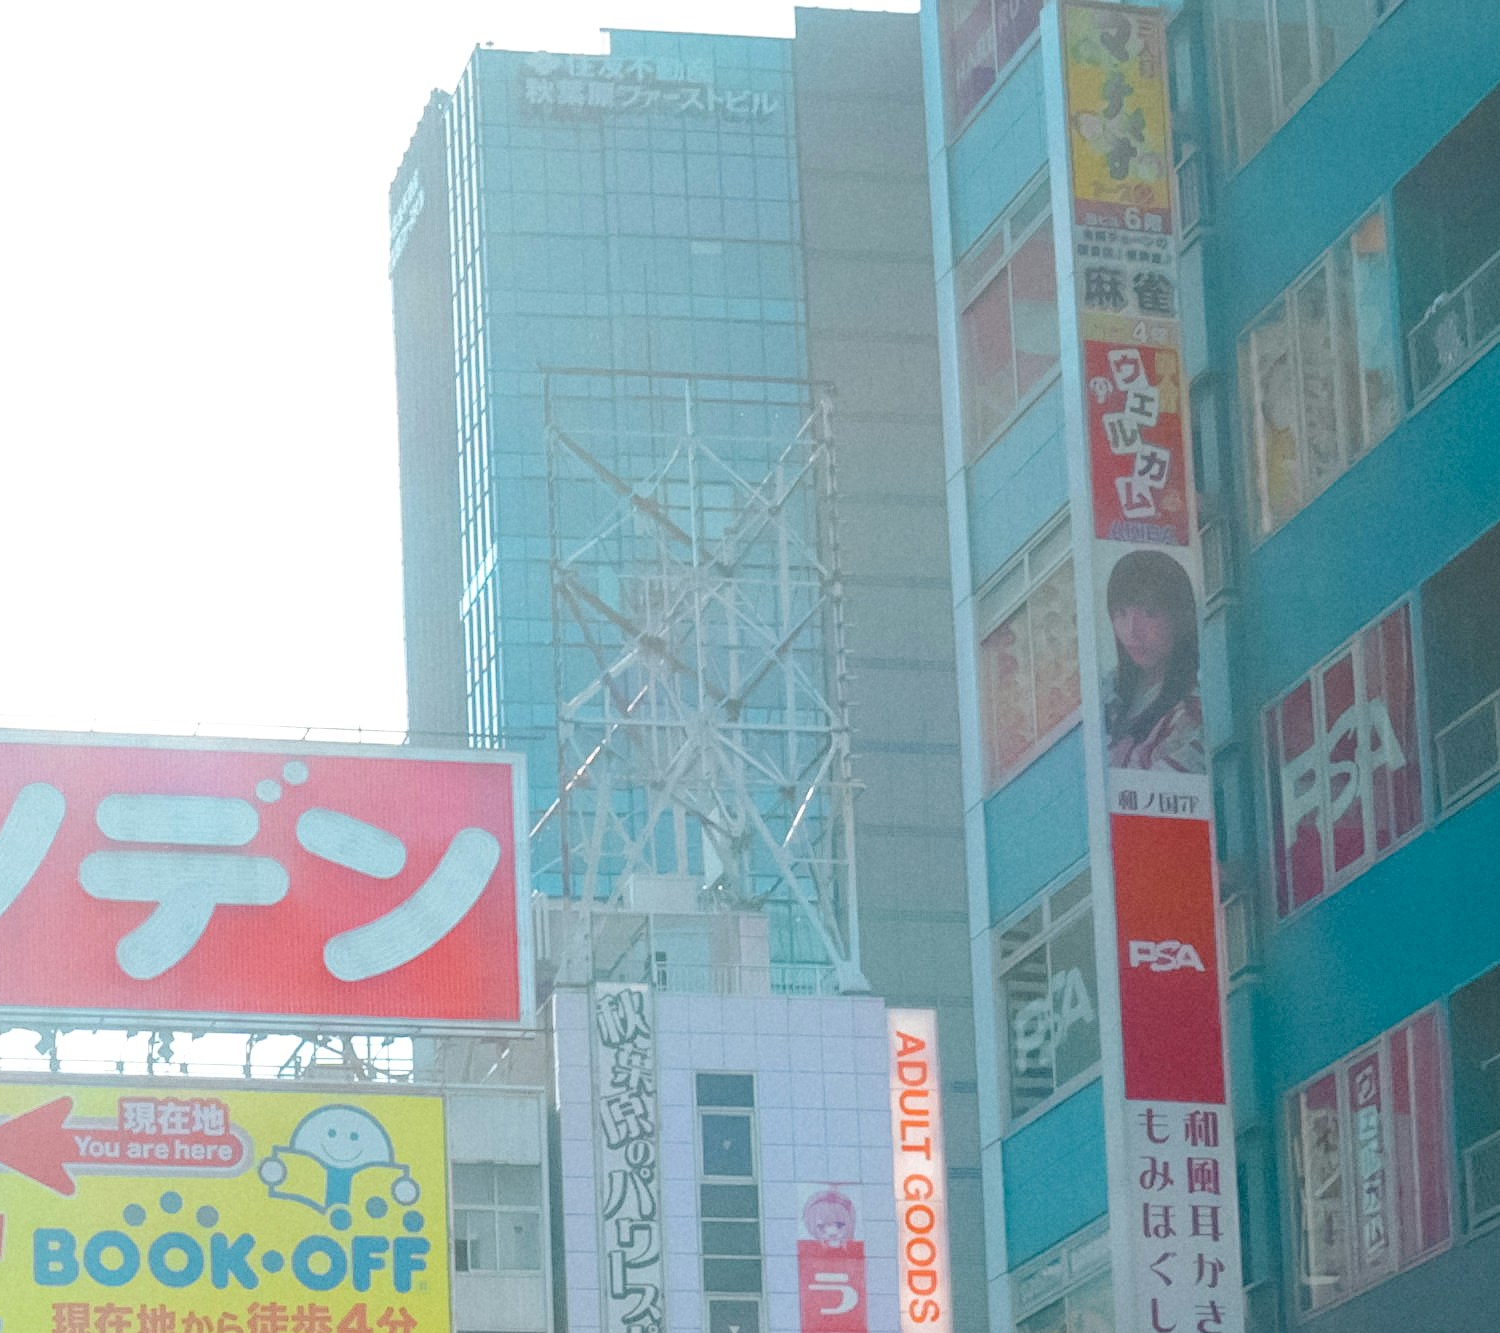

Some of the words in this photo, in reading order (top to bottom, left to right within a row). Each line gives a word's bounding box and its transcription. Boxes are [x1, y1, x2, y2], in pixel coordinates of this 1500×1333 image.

[1085, 268, 1174, 317] 麻雀
[1129, 939, 1205, 972] PSA
[896, 1031, 931, 1160] ADULT
[122, 1101, 227, 1136] 現在地
[73, 1136, 121, 1160] You
[125, 1140, 170, 1160] are
[174, 1138, 233, 1162] here
[902, 1174, 939, 1324] GOODS
